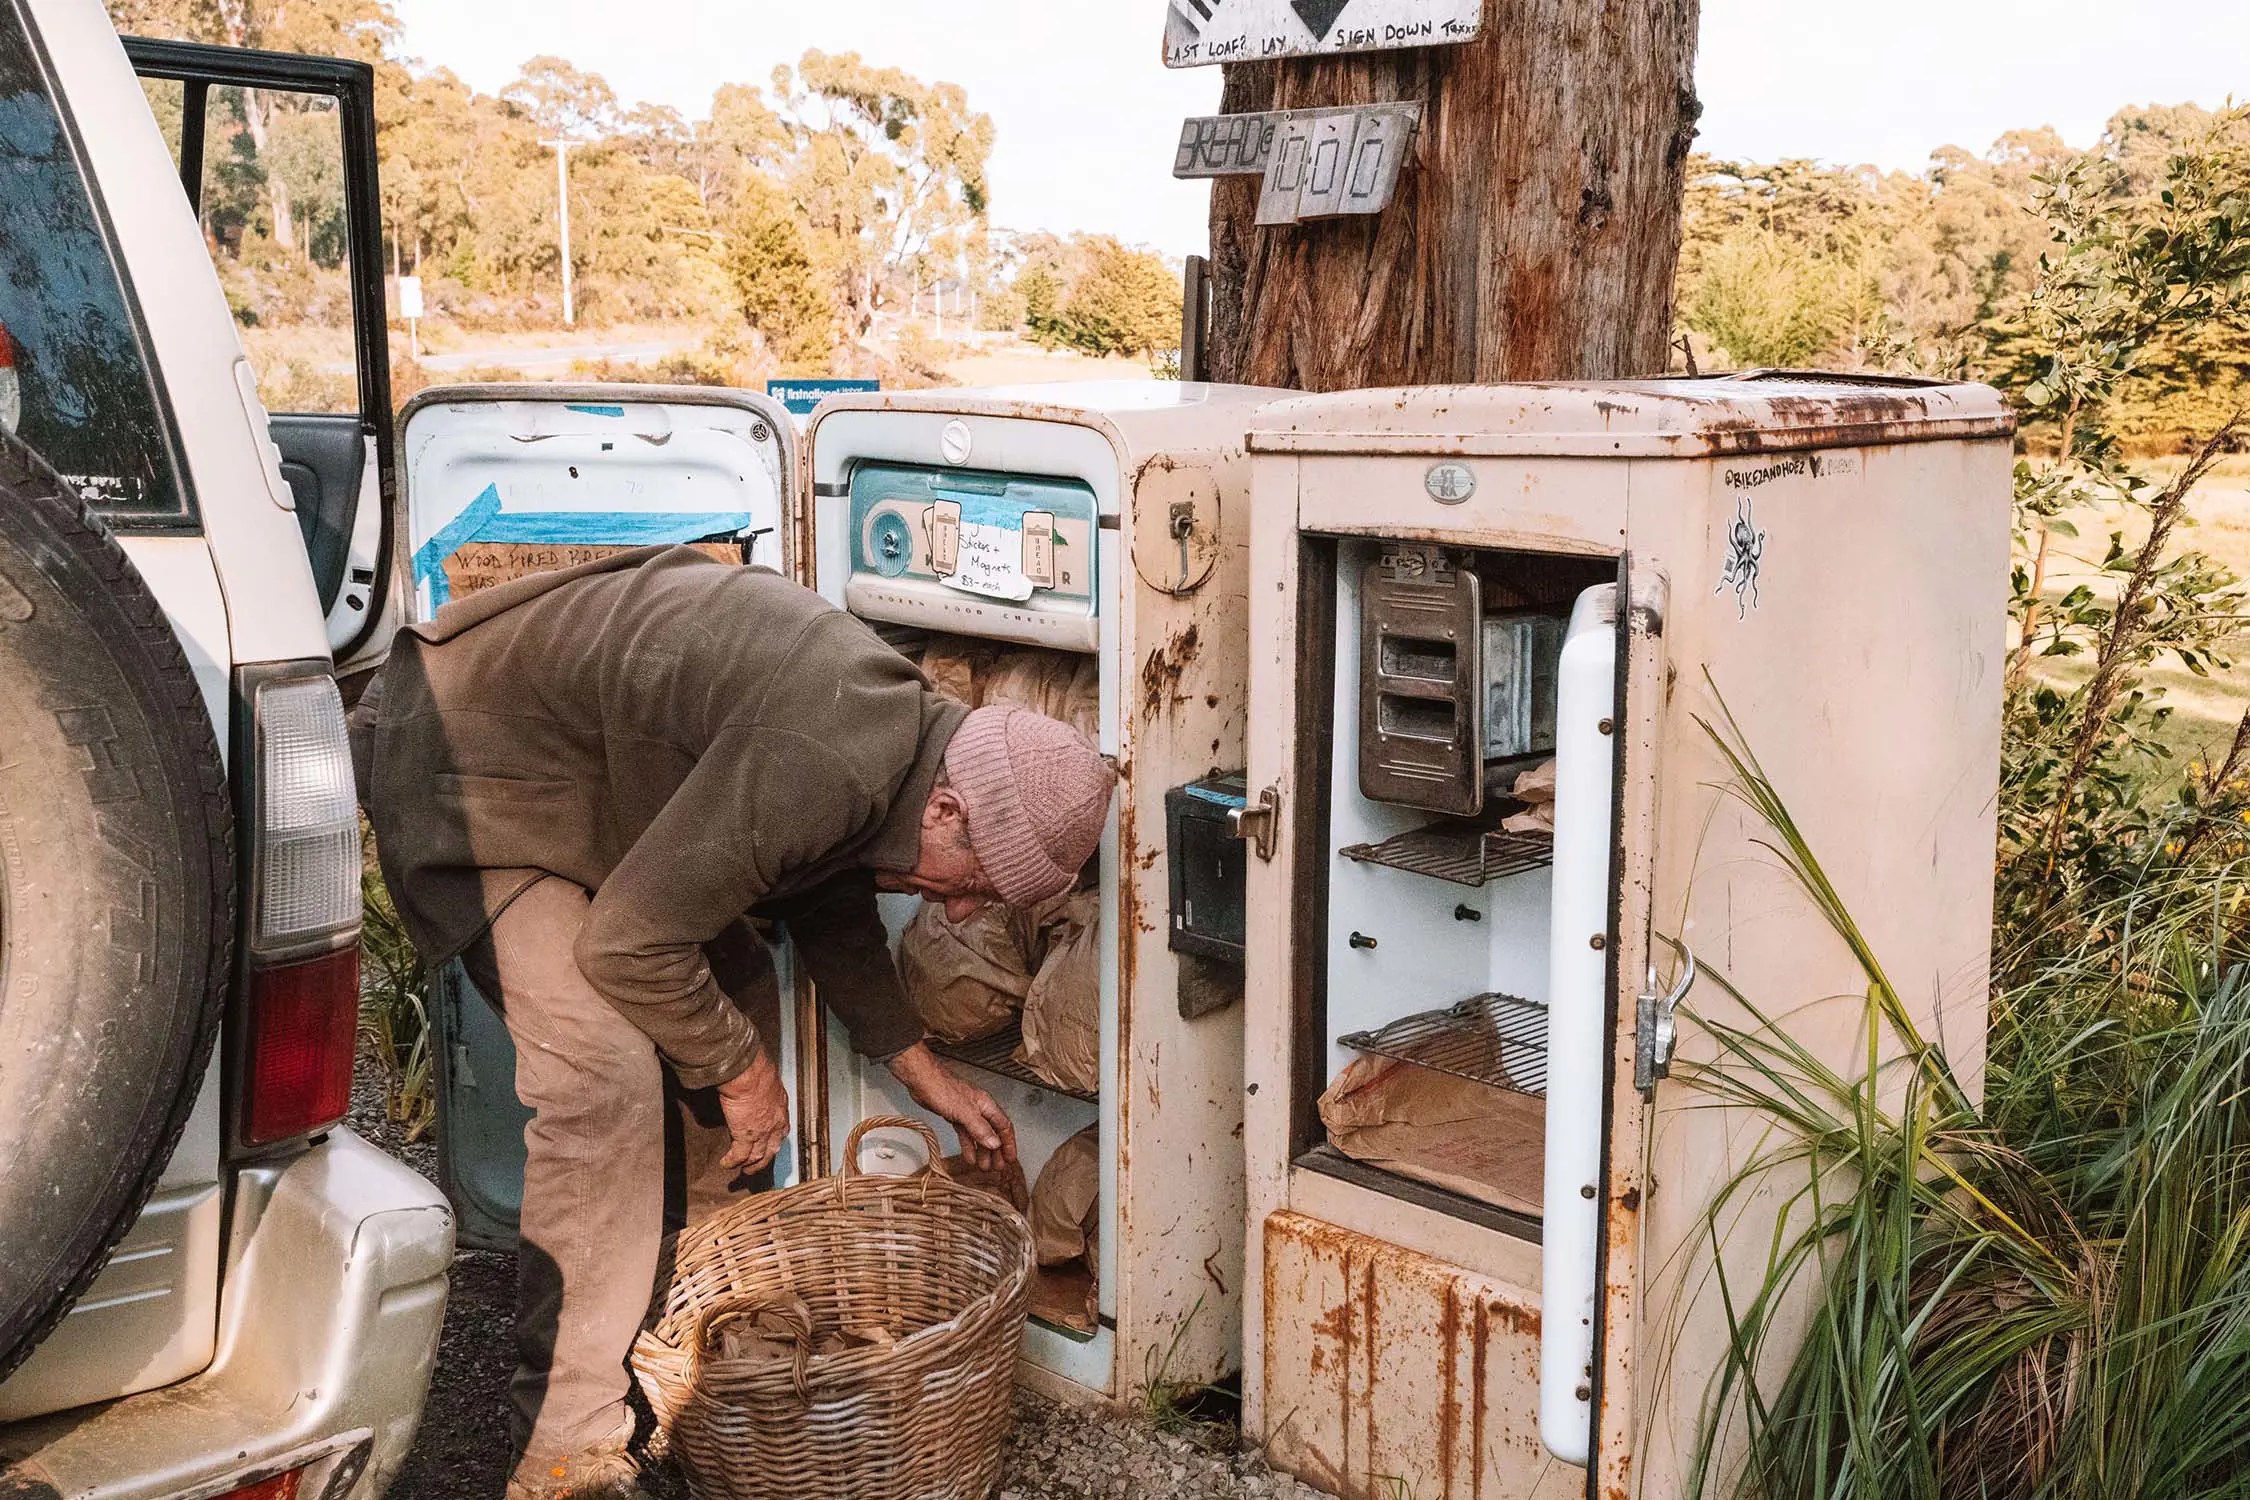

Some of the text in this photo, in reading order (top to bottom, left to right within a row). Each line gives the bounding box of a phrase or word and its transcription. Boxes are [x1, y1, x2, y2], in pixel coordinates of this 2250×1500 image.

[1167, 44, 1199, 62] LAST
[1208, 35, 1247, 57] LOAF?
[1262, 35, 1286, 54] LAY
[1335, 27, 1375, 47] SIGN
[1386, 20, 1432, 41] DOWN
[1175, 115, 1264, 170] BREAD
[455, 551, 502, 569] WOOD
[468, 575, 496, 591] HAS
